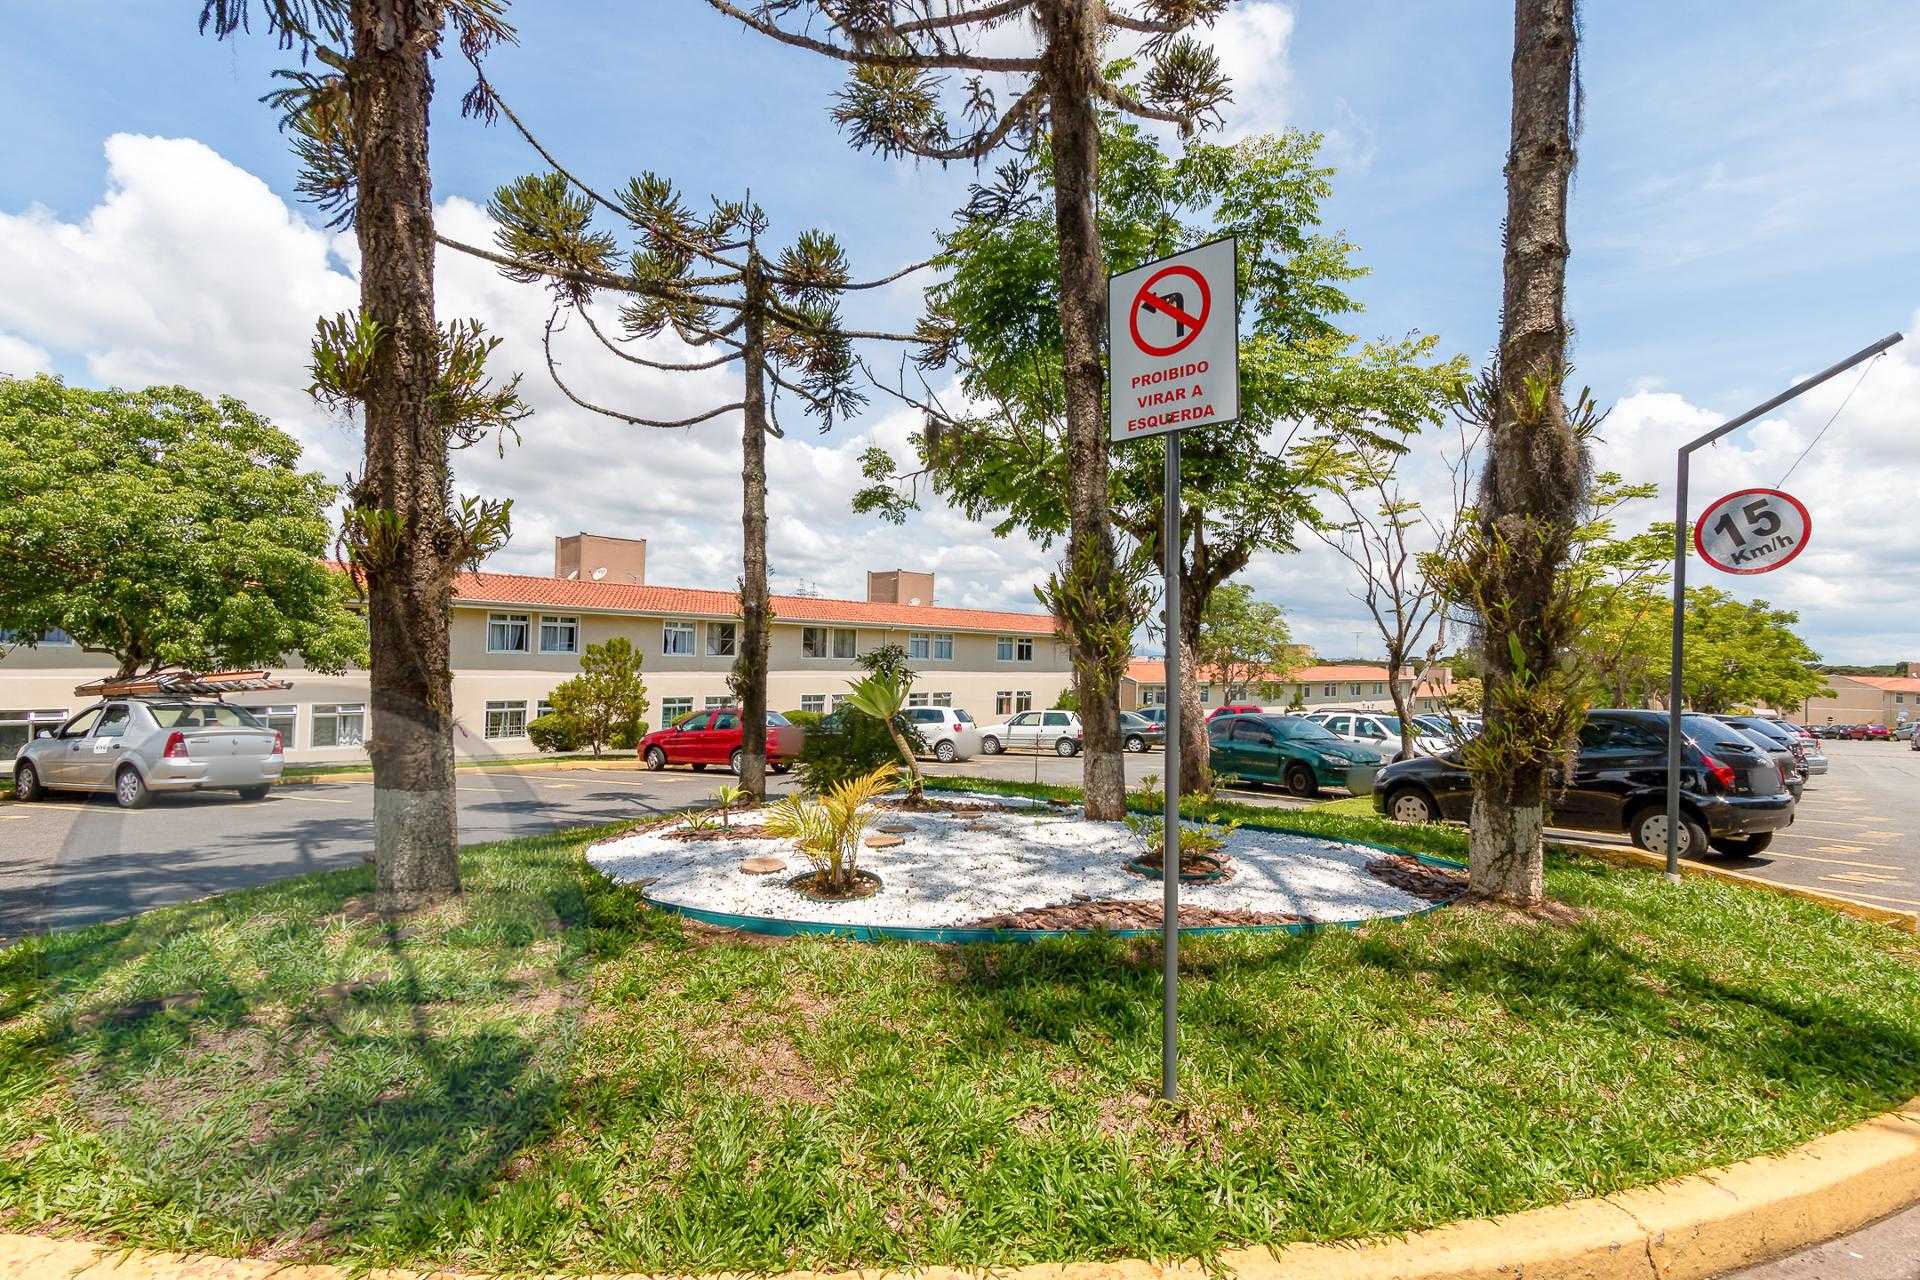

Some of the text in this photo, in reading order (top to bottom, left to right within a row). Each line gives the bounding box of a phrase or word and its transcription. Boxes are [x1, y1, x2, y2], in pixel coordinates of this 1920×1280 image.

[1131, 360, 1209, 389] PROIBIDO
[1137, 384, 1203, 408] VIRAR A
[1127, 404, 1215, 432] ESQUERDA
[1714, 498, 1781, 547] 15
